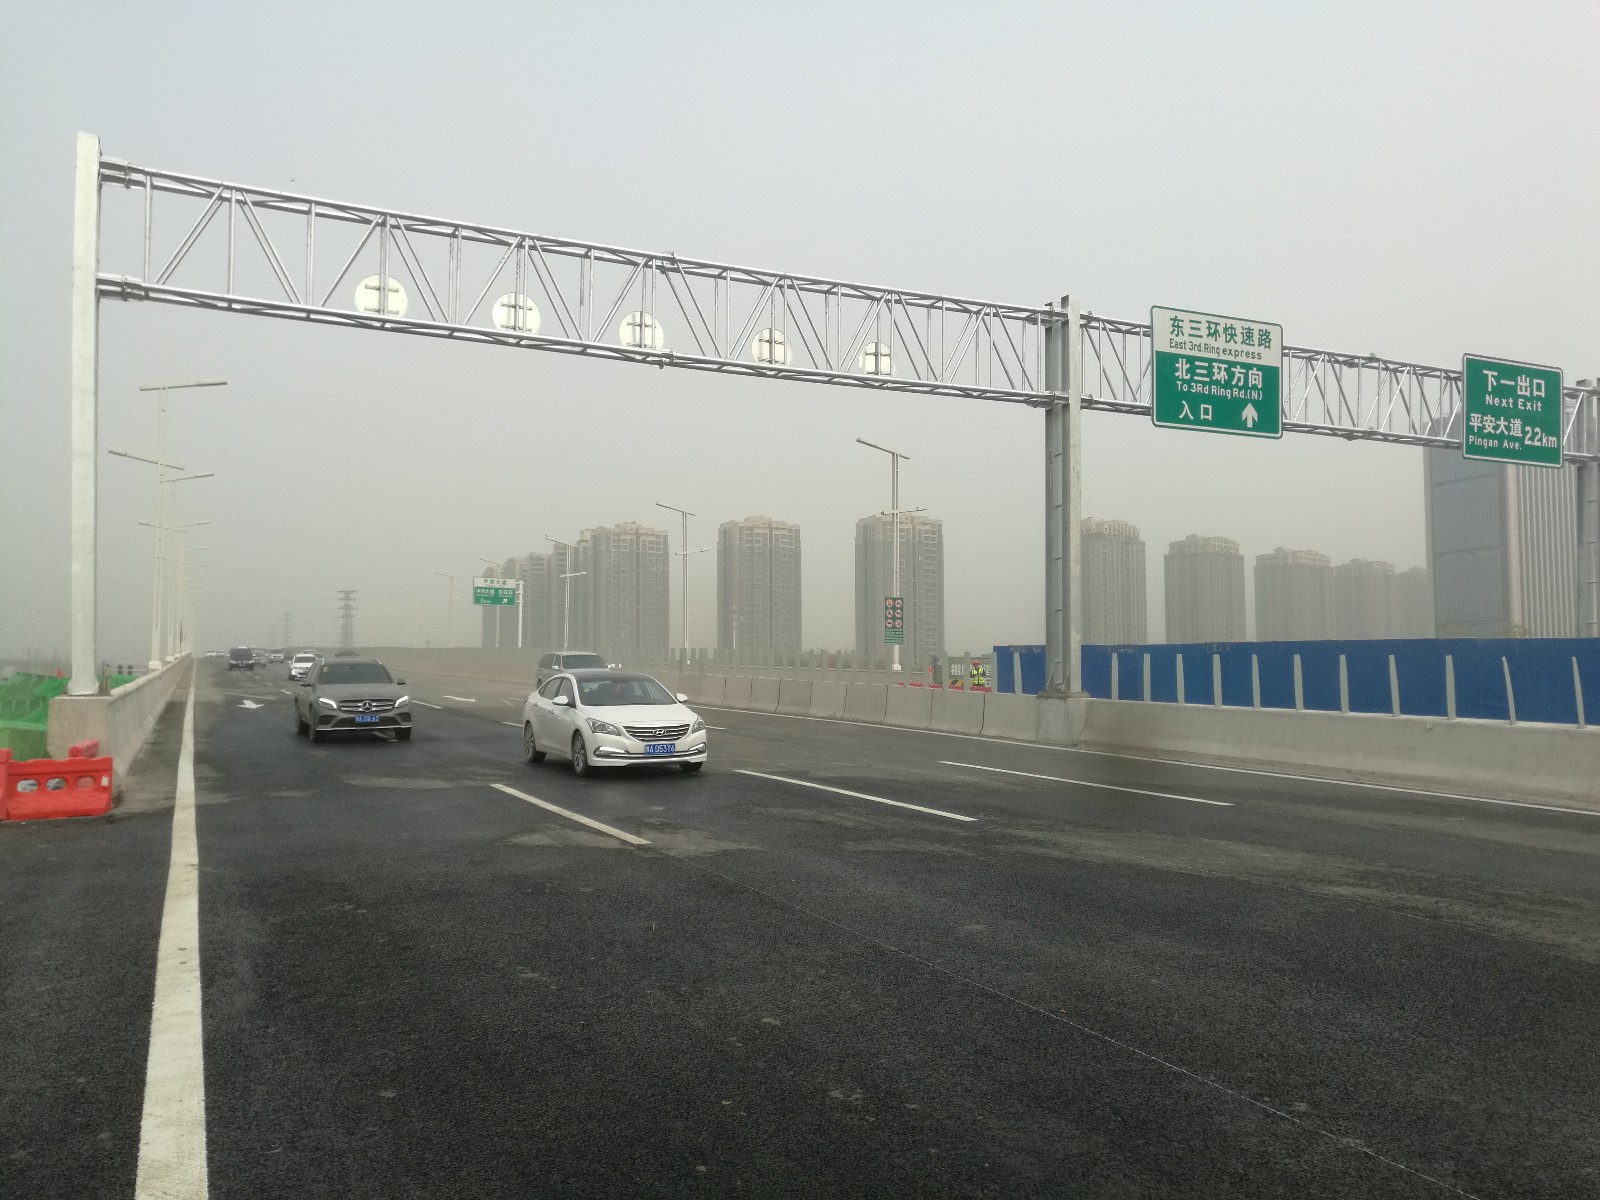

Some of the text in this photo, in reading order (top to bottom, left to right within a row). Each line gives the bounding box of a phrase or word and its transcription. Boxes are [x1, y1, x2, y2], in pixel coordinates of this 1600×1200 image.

[1169, 315, 1272, 350] 东三环快速路
[1169, 338, 1186, 349] East
[1222, 346, 1262, 360] express
[1174, 358, 1263, 388] 北三环方向
[1482, 369, 1545, 398] 下一出口
[1176, 381, 1188, 391] To
[1190, 383, 1209, 394] 3Rd
[1211, 385, 1231, 399] Ring
[1179, 400, 1213, 421] 入口
[1485, 394, 1542, 411] Next Exit
[1469, 413, 1523, 437] 平安大道
[1468, 435, 1522, 450] Pingan Ave.
